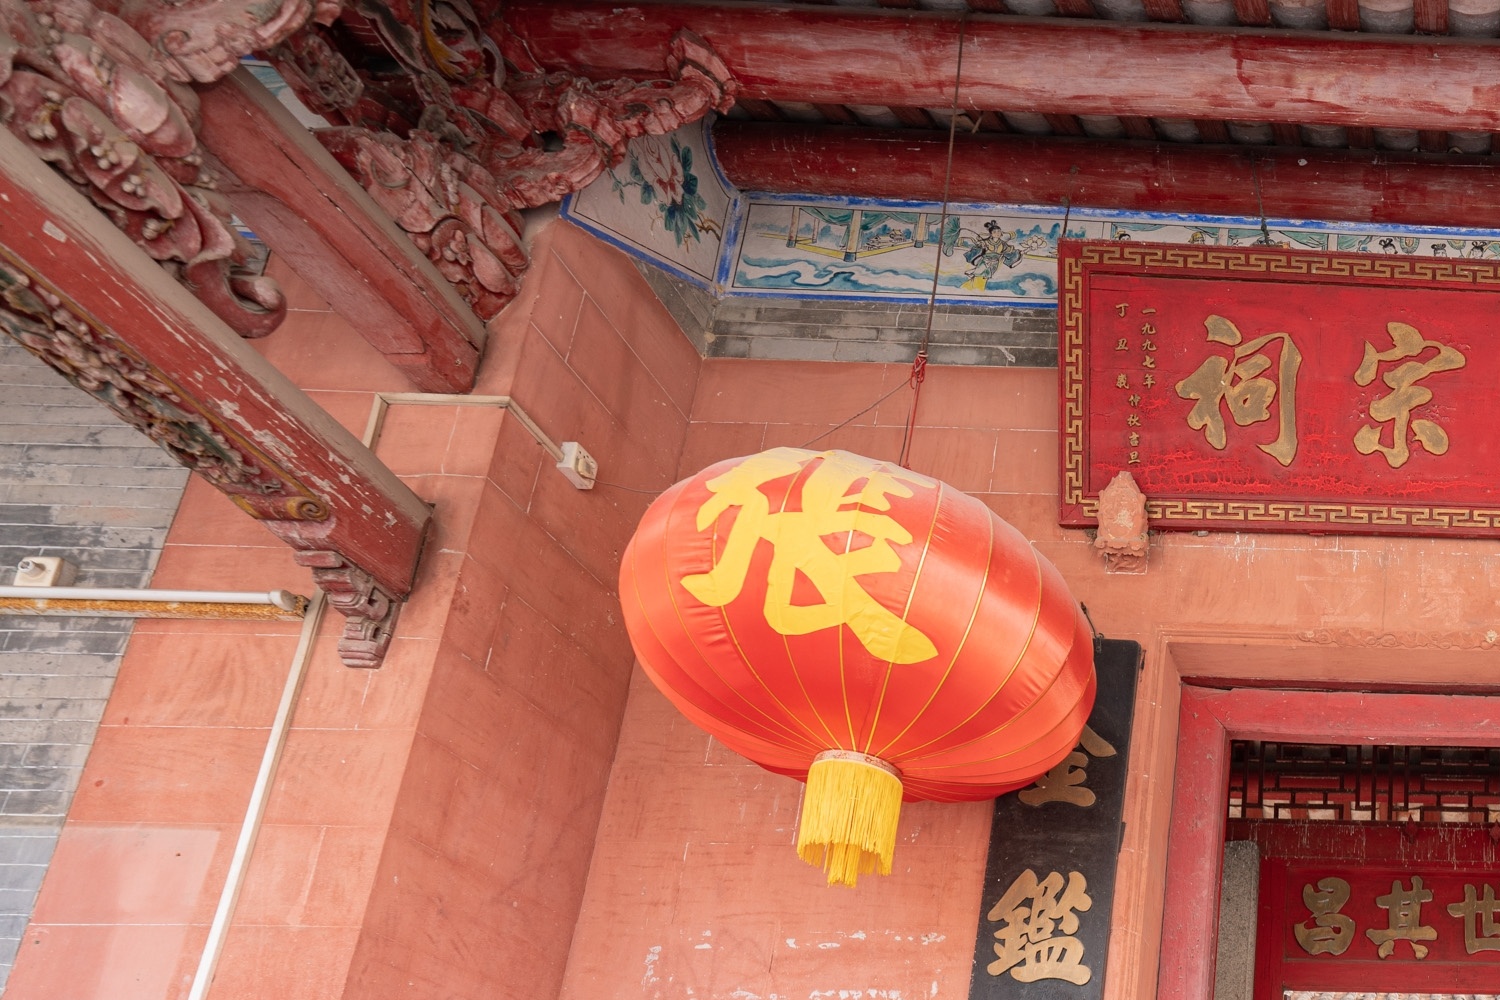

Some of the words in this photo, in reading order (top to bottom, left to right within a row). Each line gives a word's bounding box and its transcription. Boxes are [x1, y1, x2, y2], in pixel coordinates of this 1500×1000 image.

[1141, 307, 1157, 389] 一九九七年
[680, 446, 939, 665] 張
